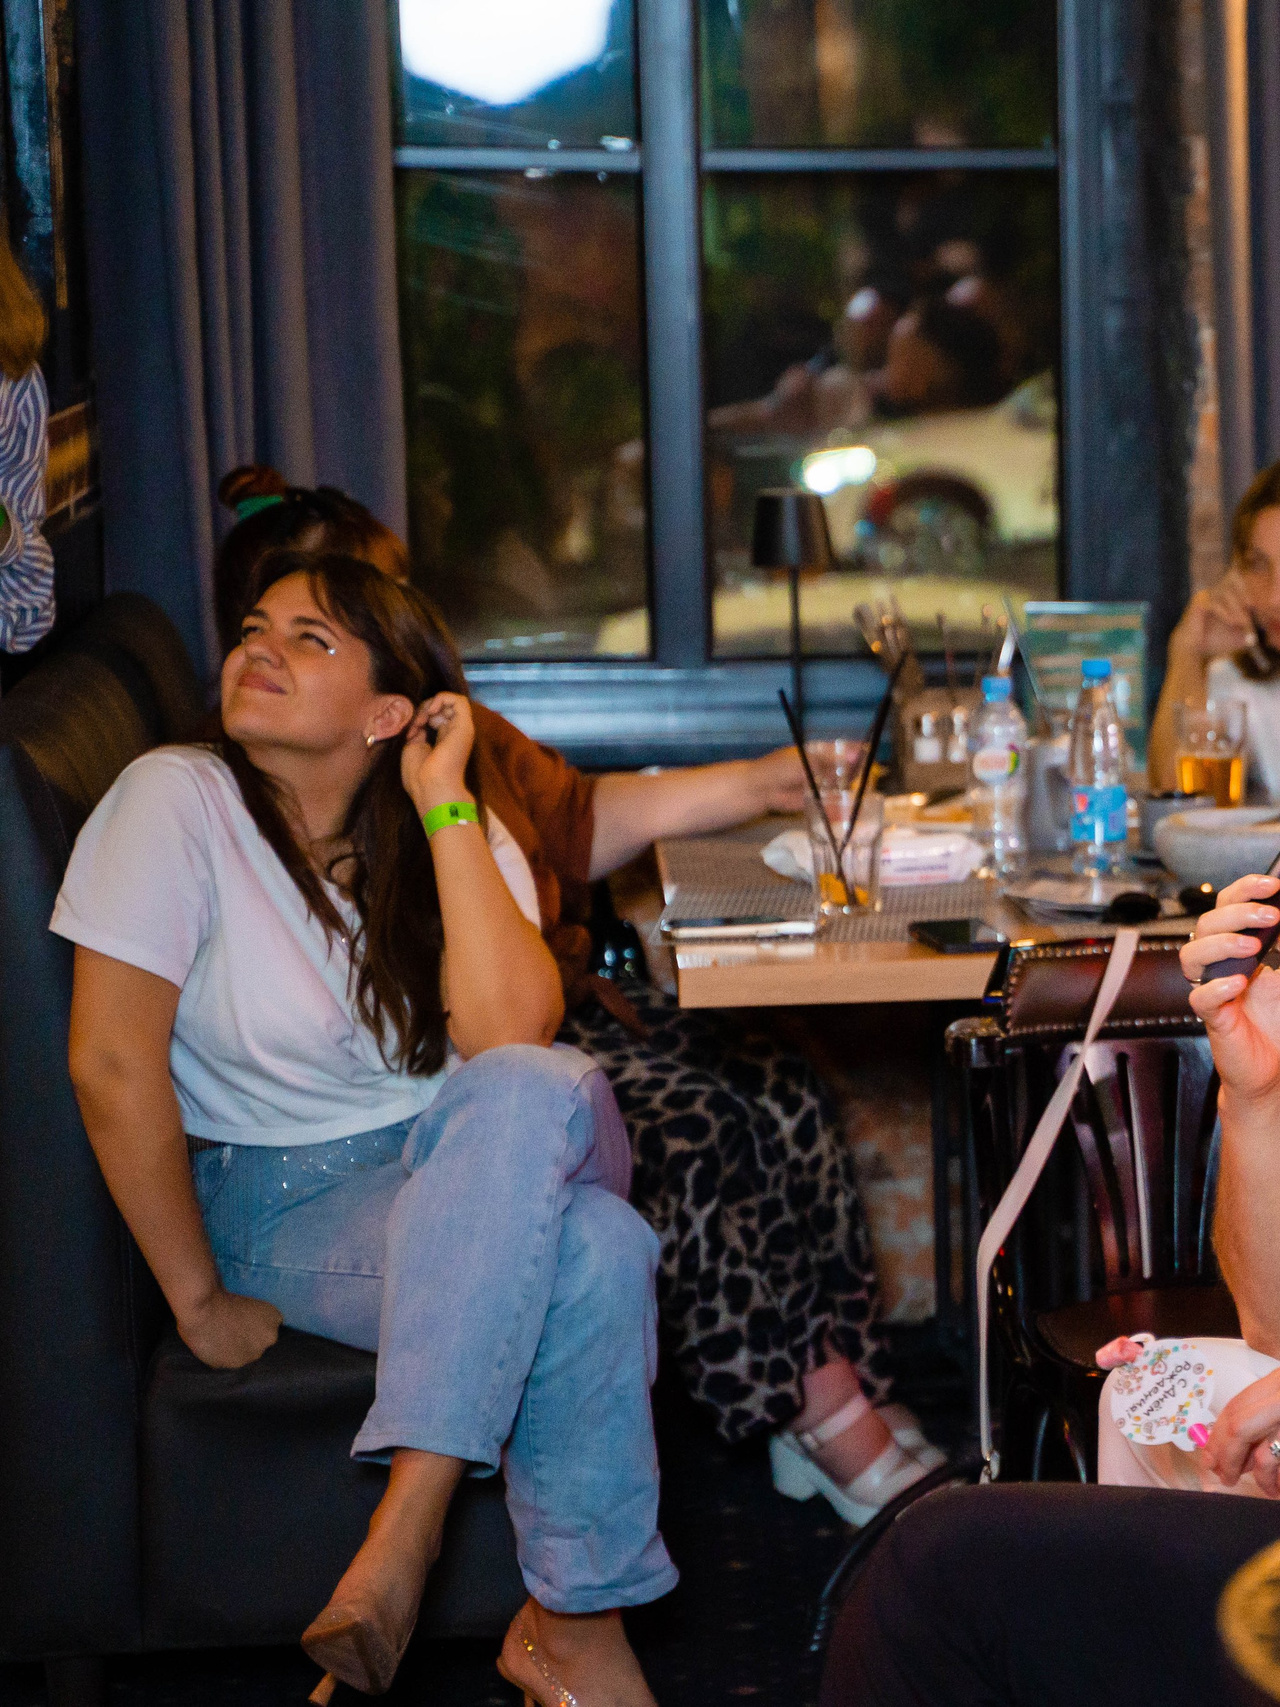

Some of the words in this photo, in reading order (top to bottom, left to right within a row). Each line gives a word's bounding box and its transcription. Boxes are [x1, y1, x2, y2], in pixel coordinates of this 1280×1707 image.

[1126, 1361, 1191, 1418] Рождения!
[1177, 1378, 1188, 1389] С
[1143, 1385, 1176, 1416] Днём
